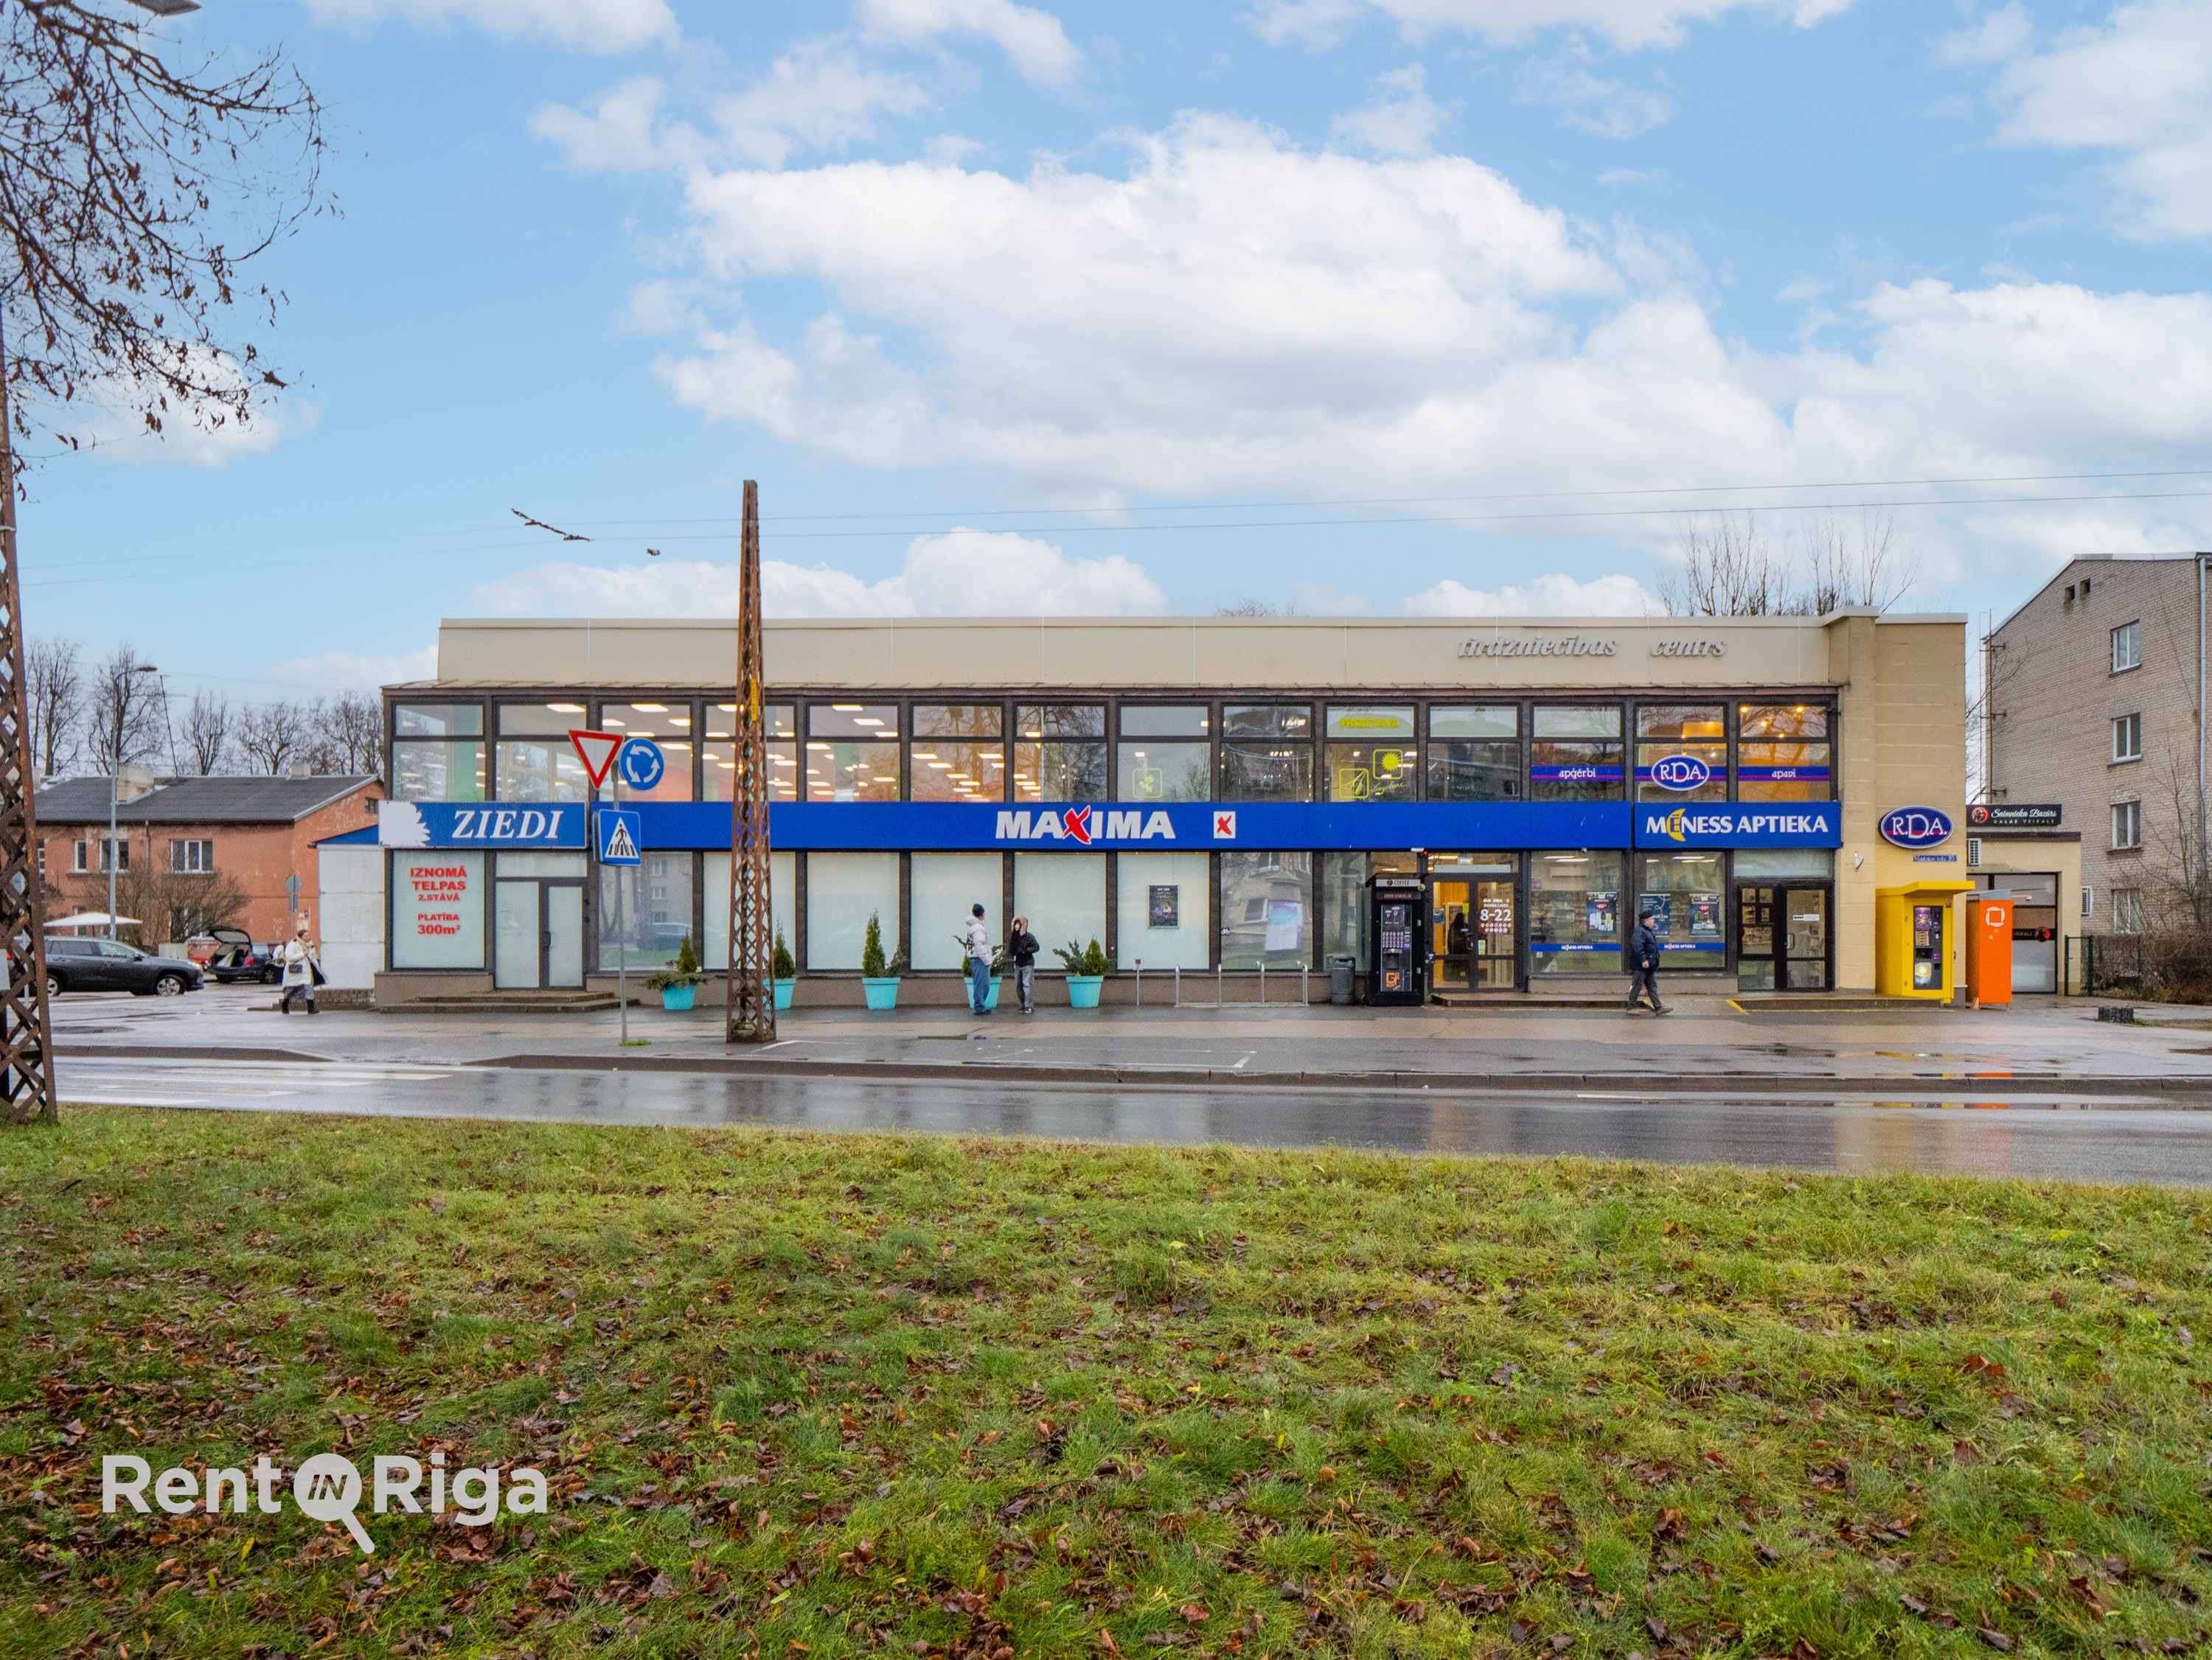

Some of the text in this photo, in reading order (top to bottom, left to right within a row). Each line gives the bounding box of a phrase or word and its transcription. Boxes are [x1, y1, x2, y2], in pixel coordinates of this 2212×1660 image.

[1458, 634, 1727, 658] tirdzniecības centrs
[1340, 717, 1399, 728] FRIZĒTAVA
[1558, 768, 1596, 780] apģērbi
[1660, 761, 1705, 783] R.D.A.
[1771, 768, 1796, 779] apavi
[1991, 808, 2056, 818] Saimnieka Bazārs
[451, 810, 564, 839] ZIEDI
[995, 805, 1176, 845] MAXIMA
[1646, 813, 1829, 834] MĒNESS APTIEKA
[1891, 813, 1947, 839] R.D.A.
[409, 865, 467, 878] IZNOMĀ
[411, 881, 466, 891] TELPAS
[417, 893, 460, 902] 2.STĀVĀ
[417, 913, 459, 921] PLATĪBA
[1480, 908, 1512, 921] 8-22
[417, 924, 460, 935] 300m²
